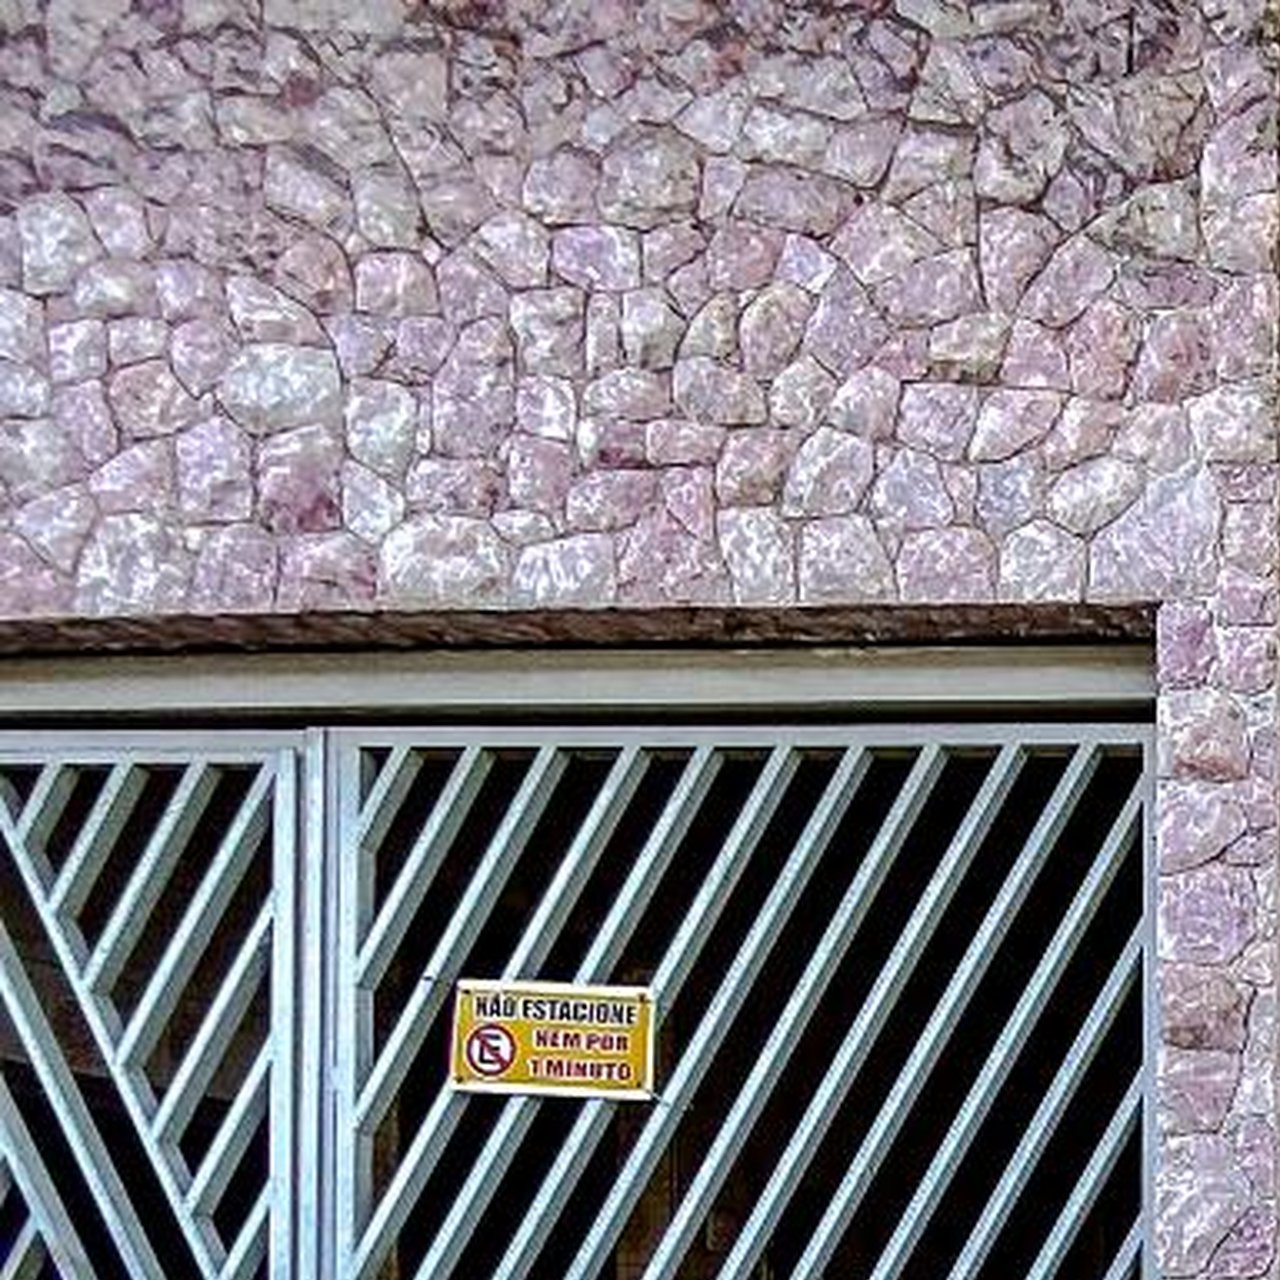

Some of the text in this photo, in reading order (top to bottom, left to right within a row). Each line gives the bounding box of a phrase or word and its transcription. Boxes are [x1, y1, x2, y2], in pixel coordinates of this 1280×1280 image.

[521, 999, 637, 1025] ESTACIONE
[535, 1029, 628, 1051] NEM POR
[529, 1058, 632, 1081] 1 MINUTO
